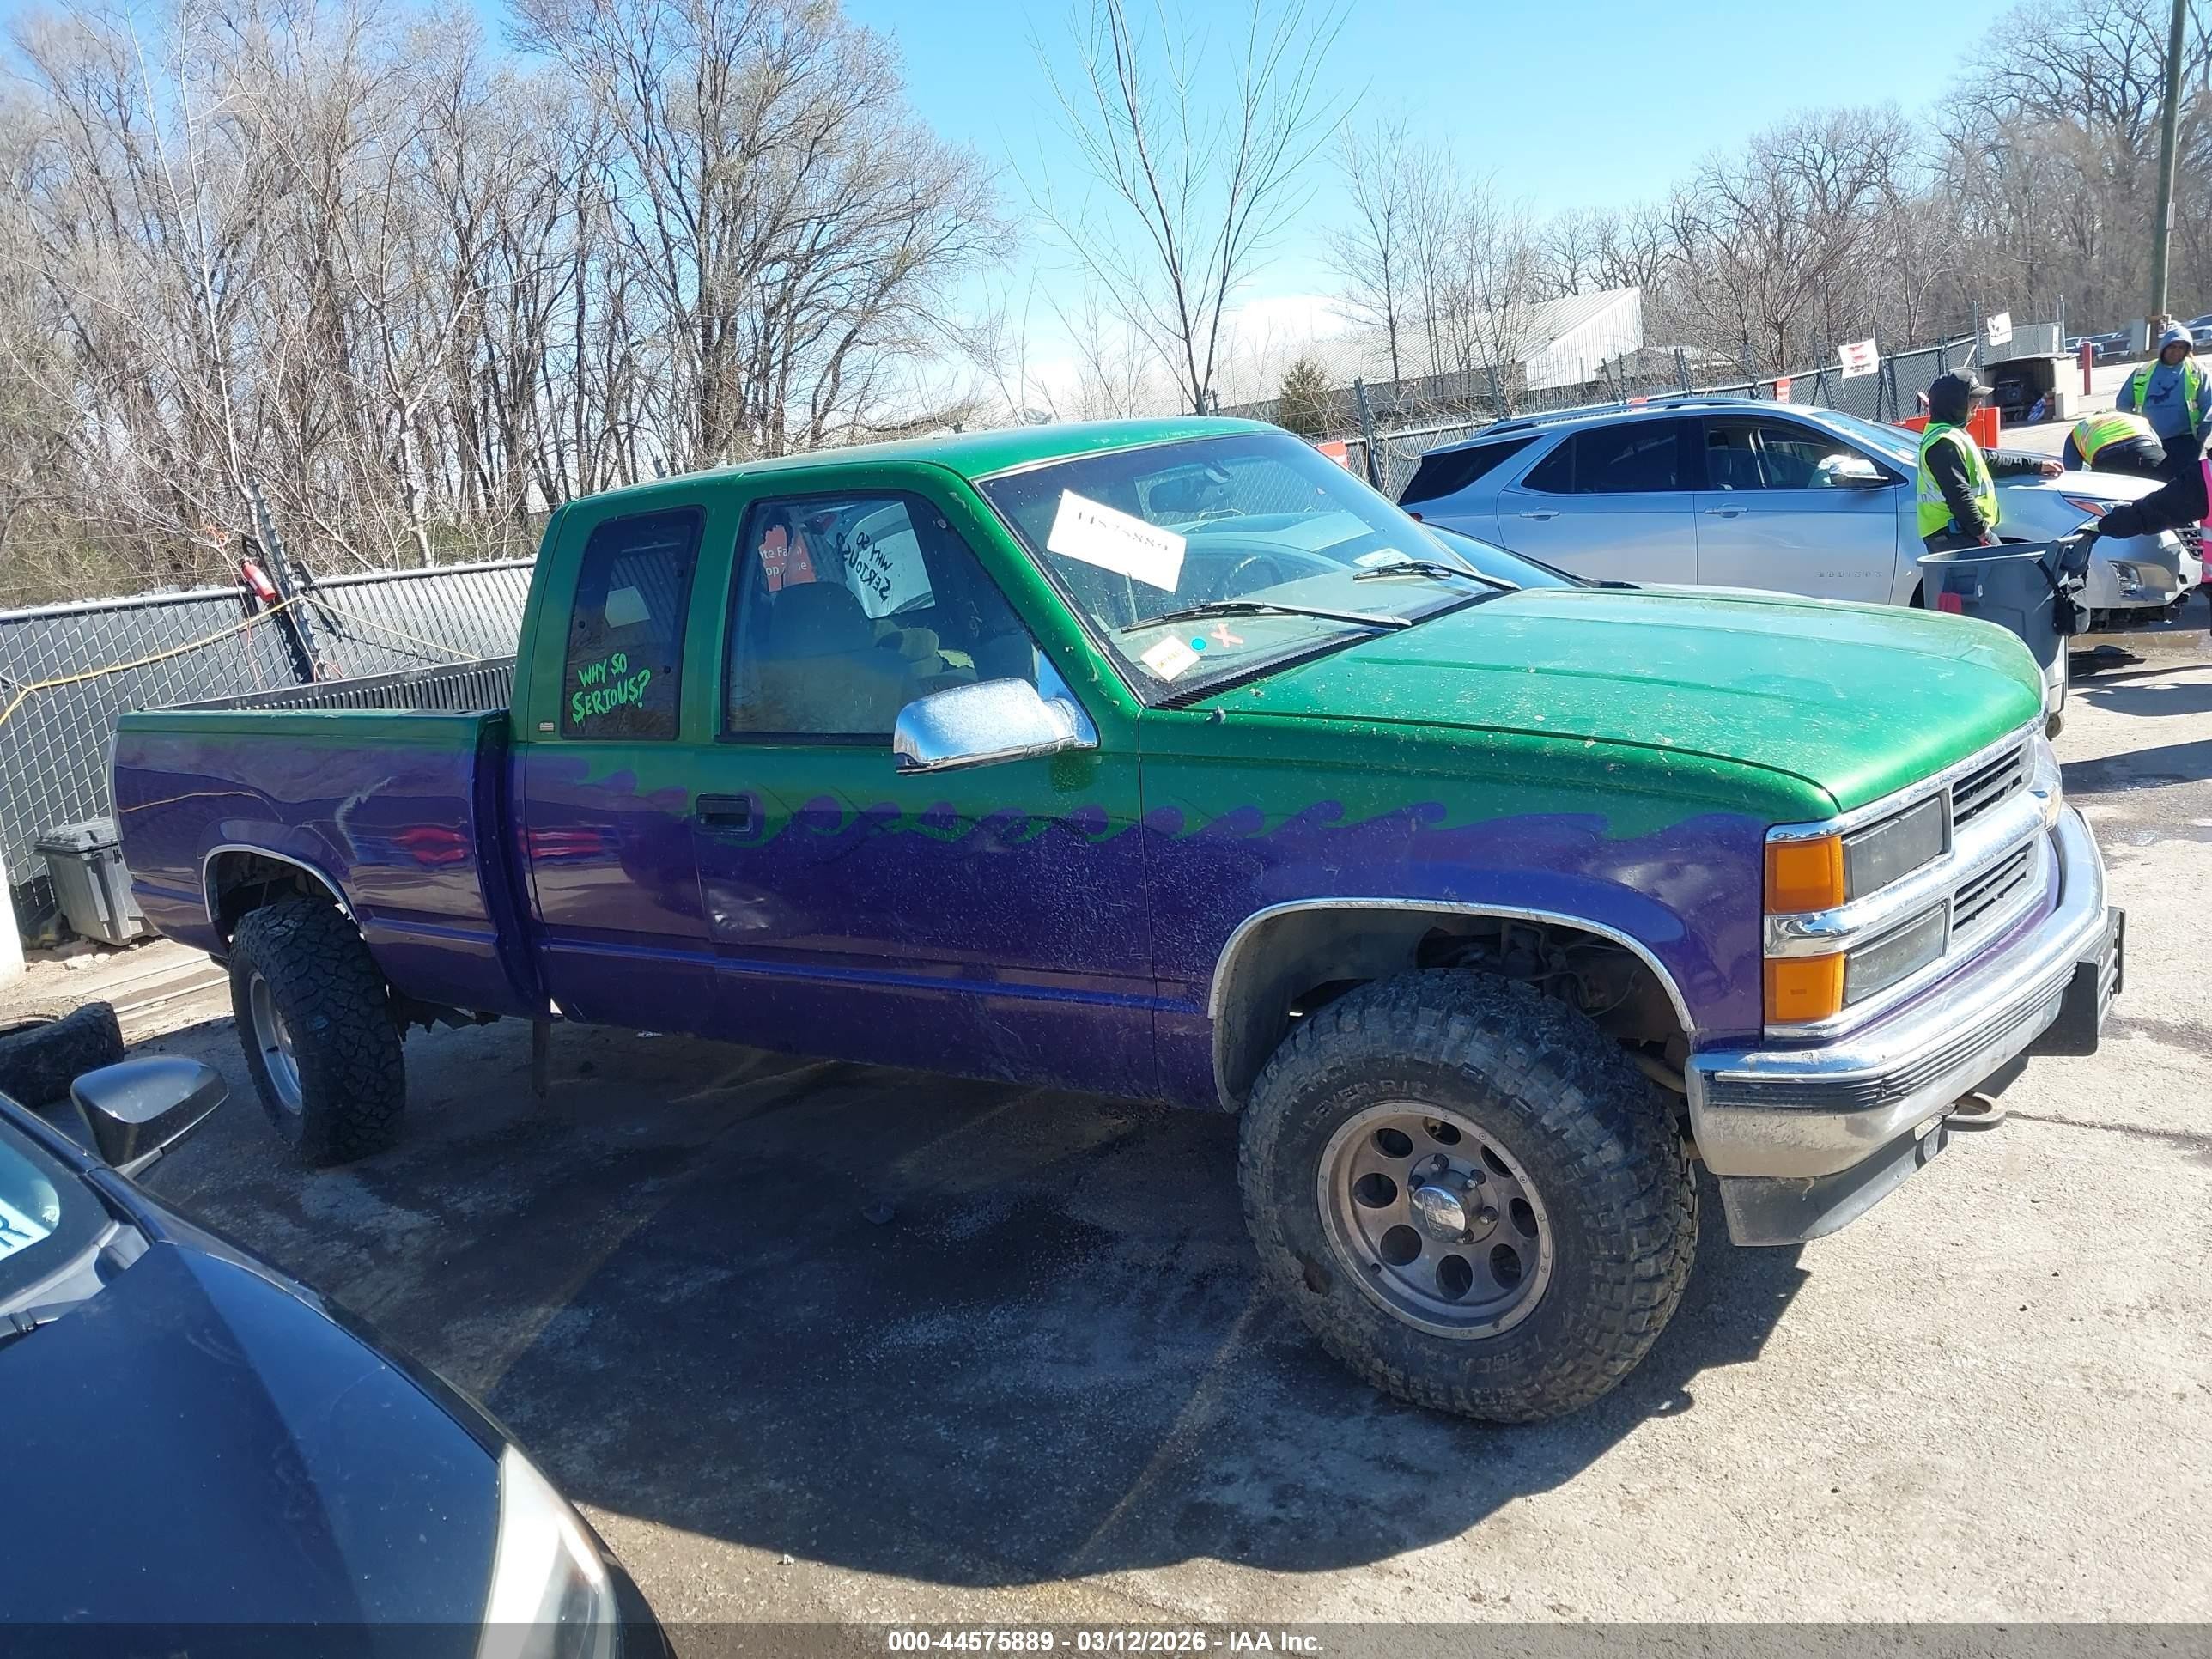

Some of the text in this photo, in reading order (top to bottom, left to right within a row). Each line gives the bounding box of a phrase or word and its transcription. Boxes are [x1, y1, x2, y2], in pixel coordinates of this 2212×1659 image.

[577, 653, 628, 687] WHY SO
[572, 669, 651, 726] SERIOUS?
